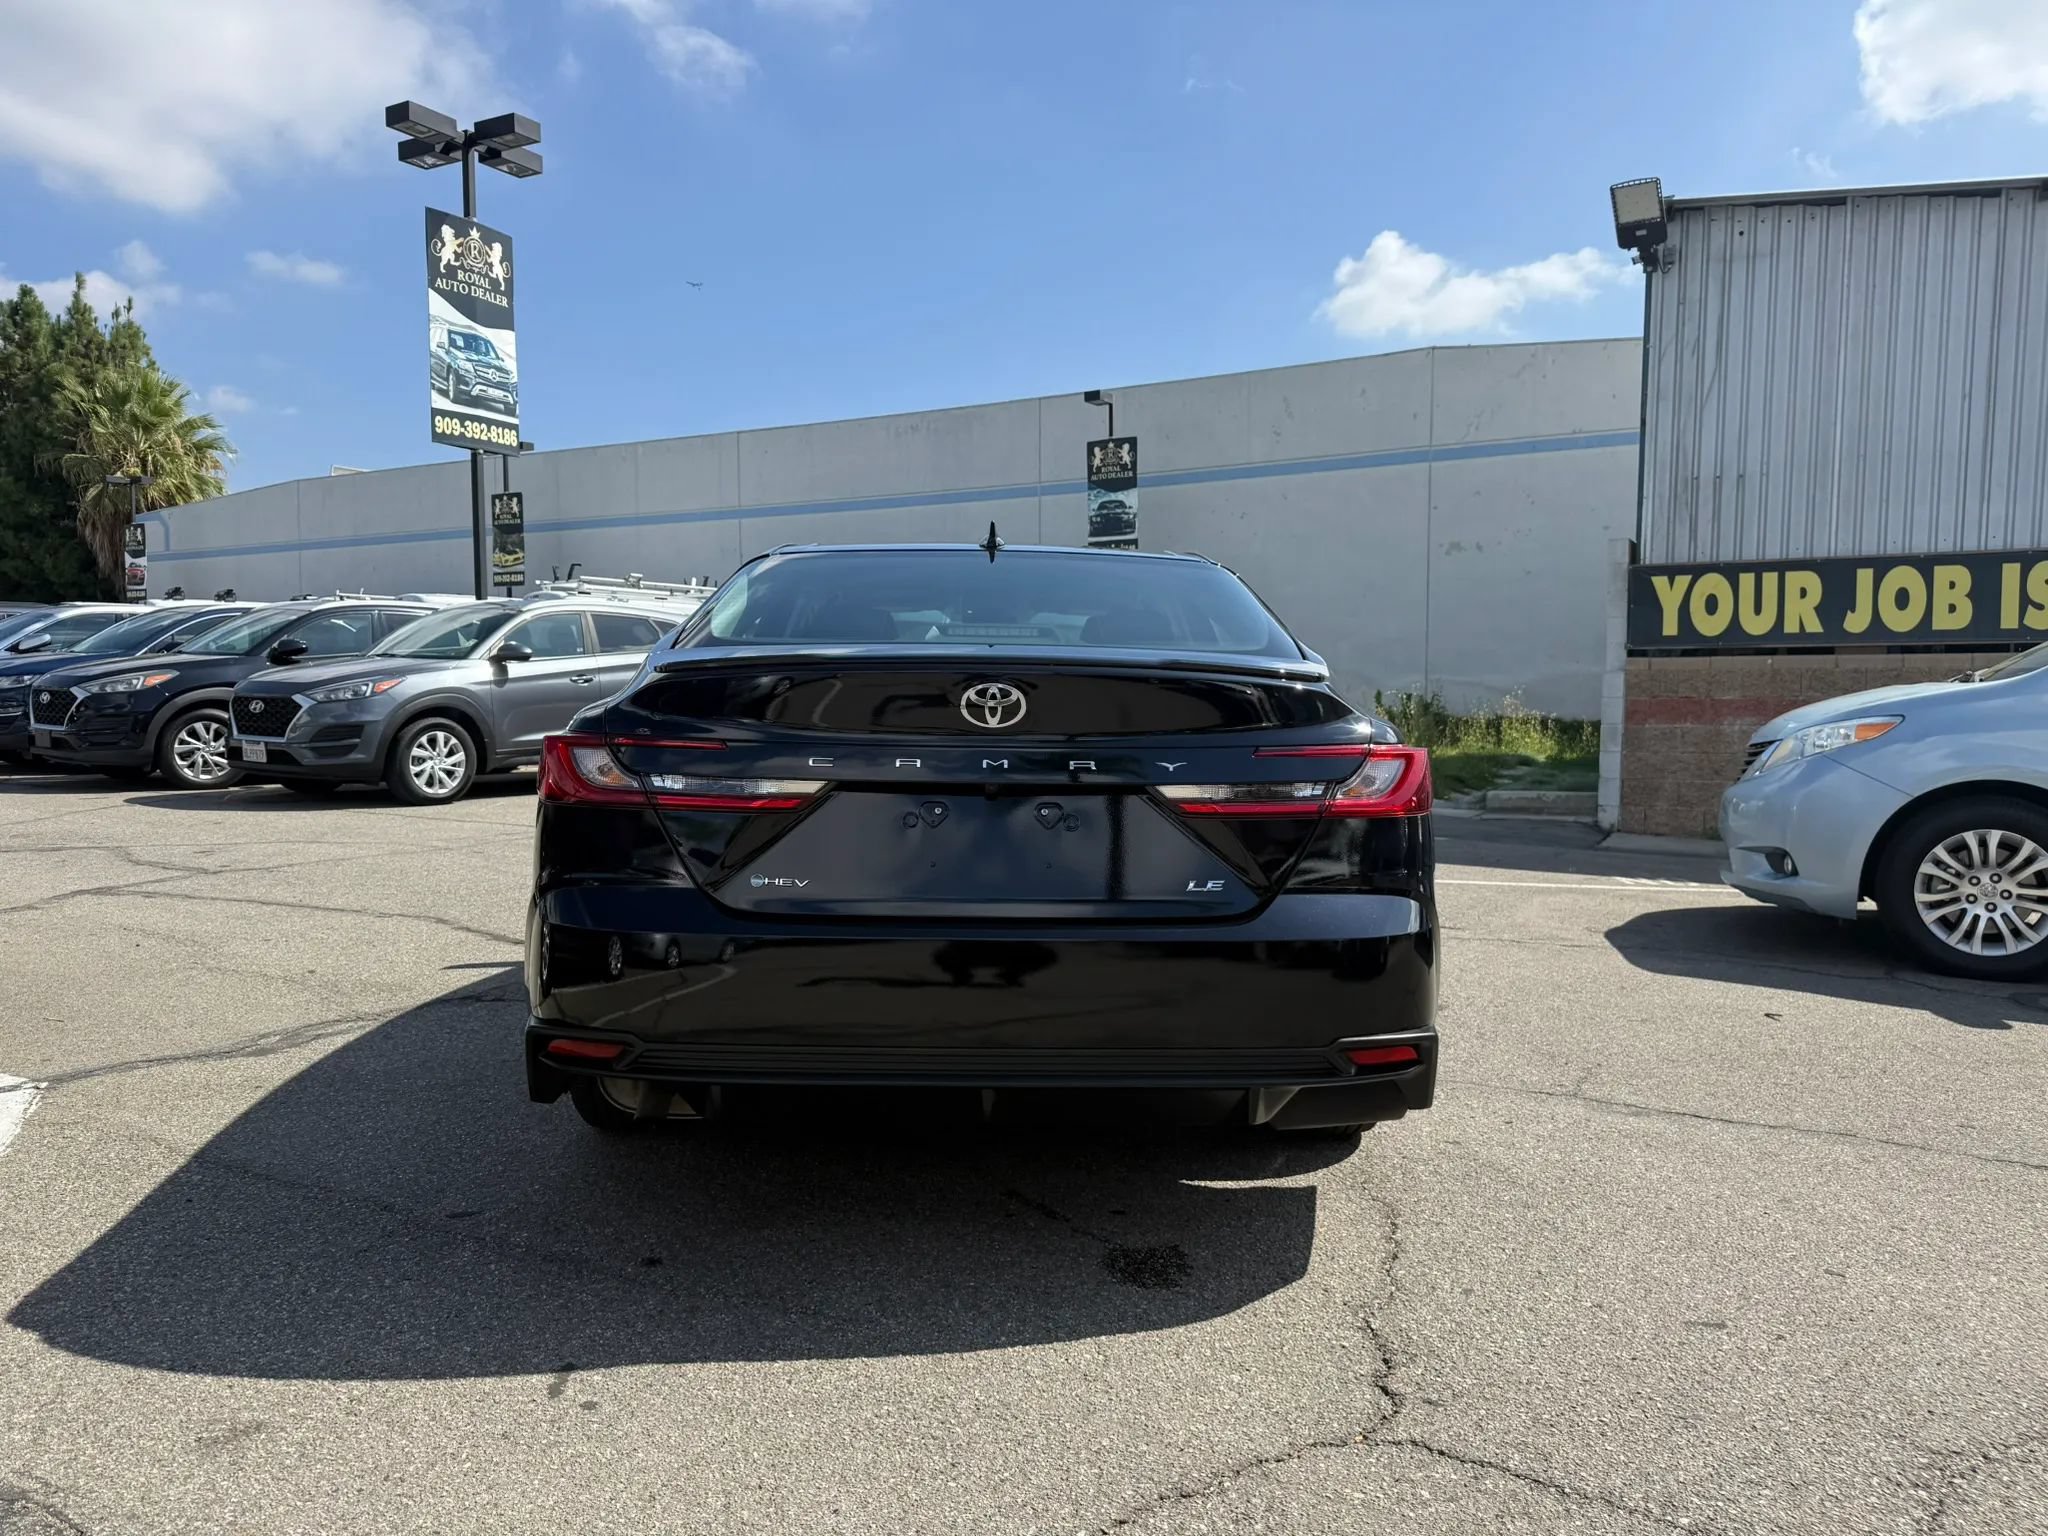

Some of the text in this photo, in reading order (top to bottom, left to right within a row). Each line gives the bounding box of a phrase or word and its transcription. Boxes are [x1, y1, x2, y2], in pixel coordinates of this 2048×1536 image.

[470, 242, 480, 259] R
[457, 269, 491, 289] ROYAL
[435, 277, 508, 308] AUTO DEALER
[434, 415, 517, 447] 909-392-8186
[1651, 560, 2048, 637] YOUR JOB IS
[809, 757, 1188, 772] CAMRY
[764, 877, 811, 887] HEV
[1186, 880, 1225, 891] LE
